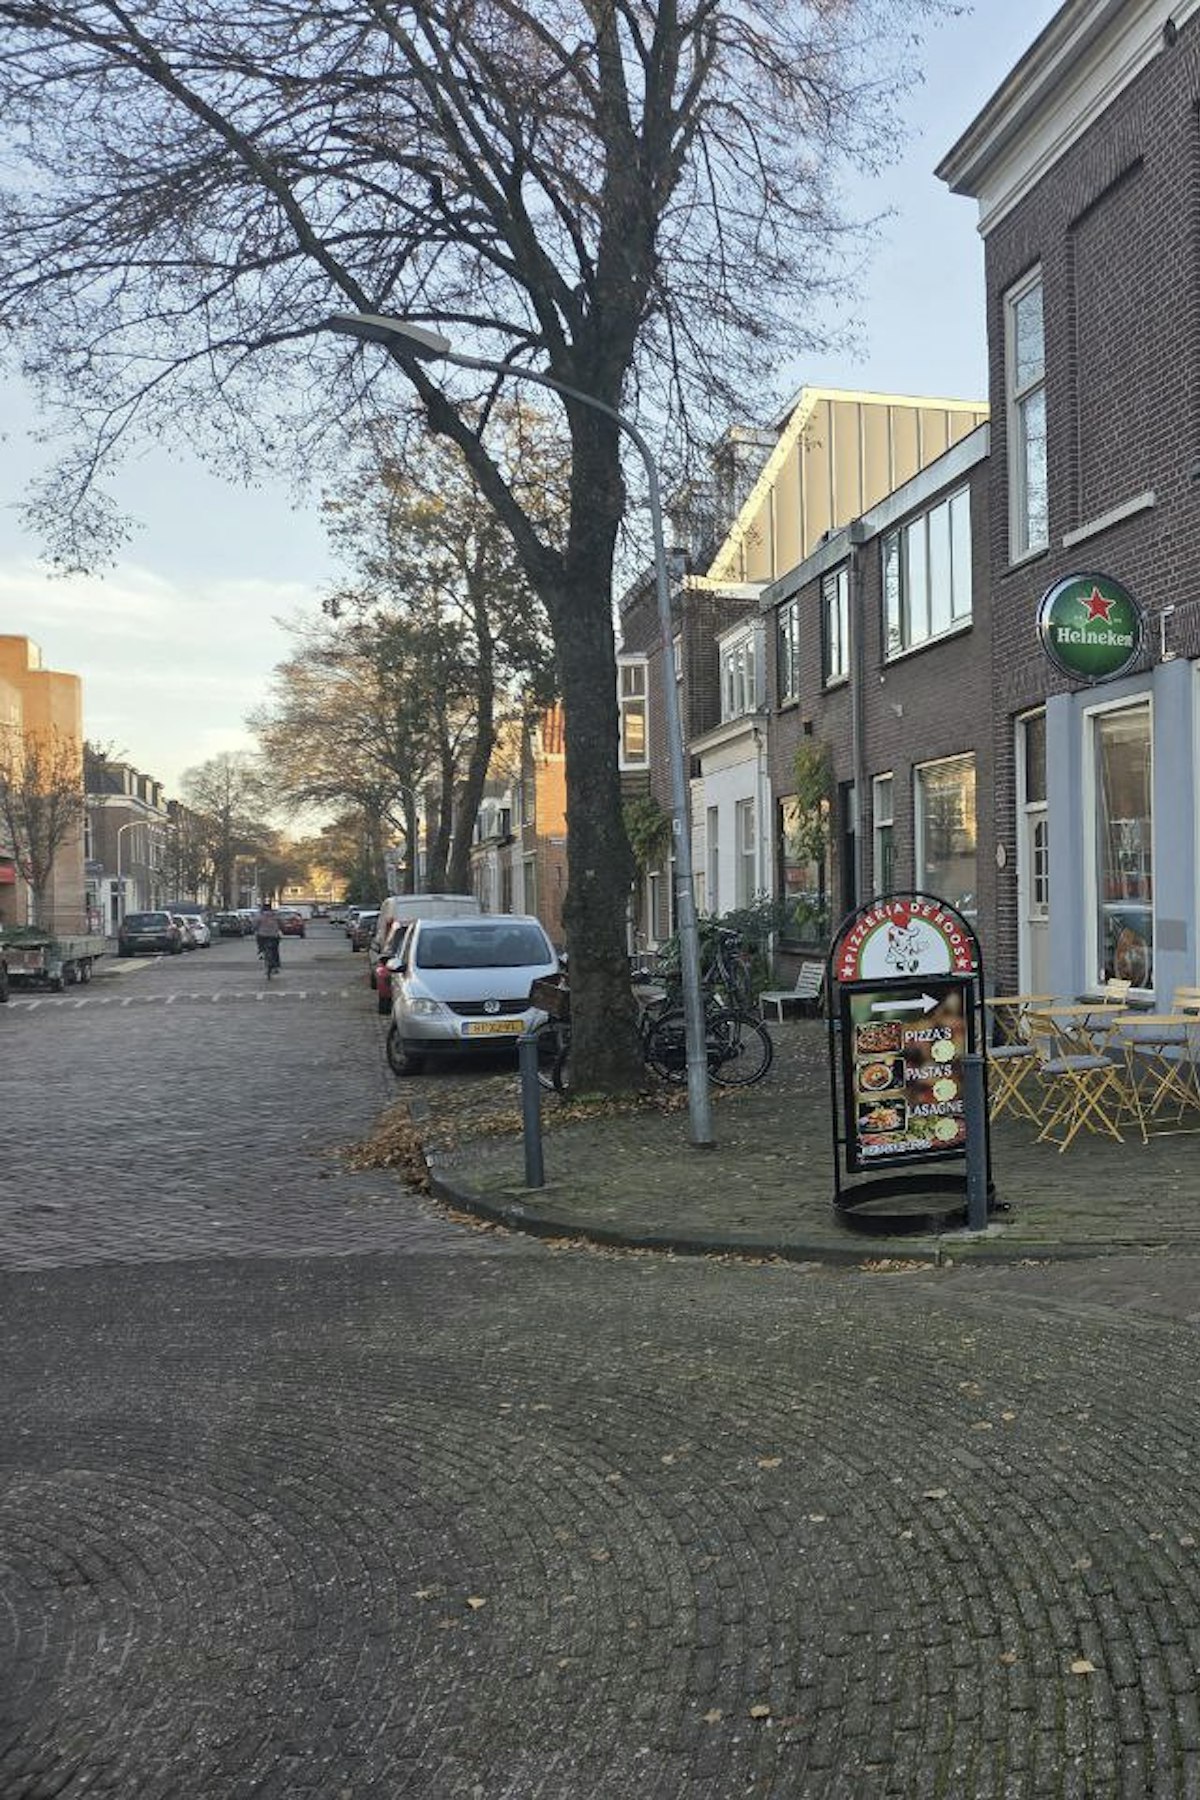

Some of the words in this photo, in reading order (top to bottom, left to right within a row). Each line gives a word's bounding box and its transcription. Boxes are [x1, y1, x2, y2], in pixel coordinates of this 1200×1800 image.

[1056, 627, 1134, 648] Heineken
[844, 902, 904, 963] PIZZERIA
[910, 902, 932, 916] DE
[935, 913, 965, 956] ROOS
[904, 1027, 952, 1043] PIZZA'S
[905, 1064, 952, 1080] PASTA'S
[907, 1100, 964, 1117] LASAGNE
